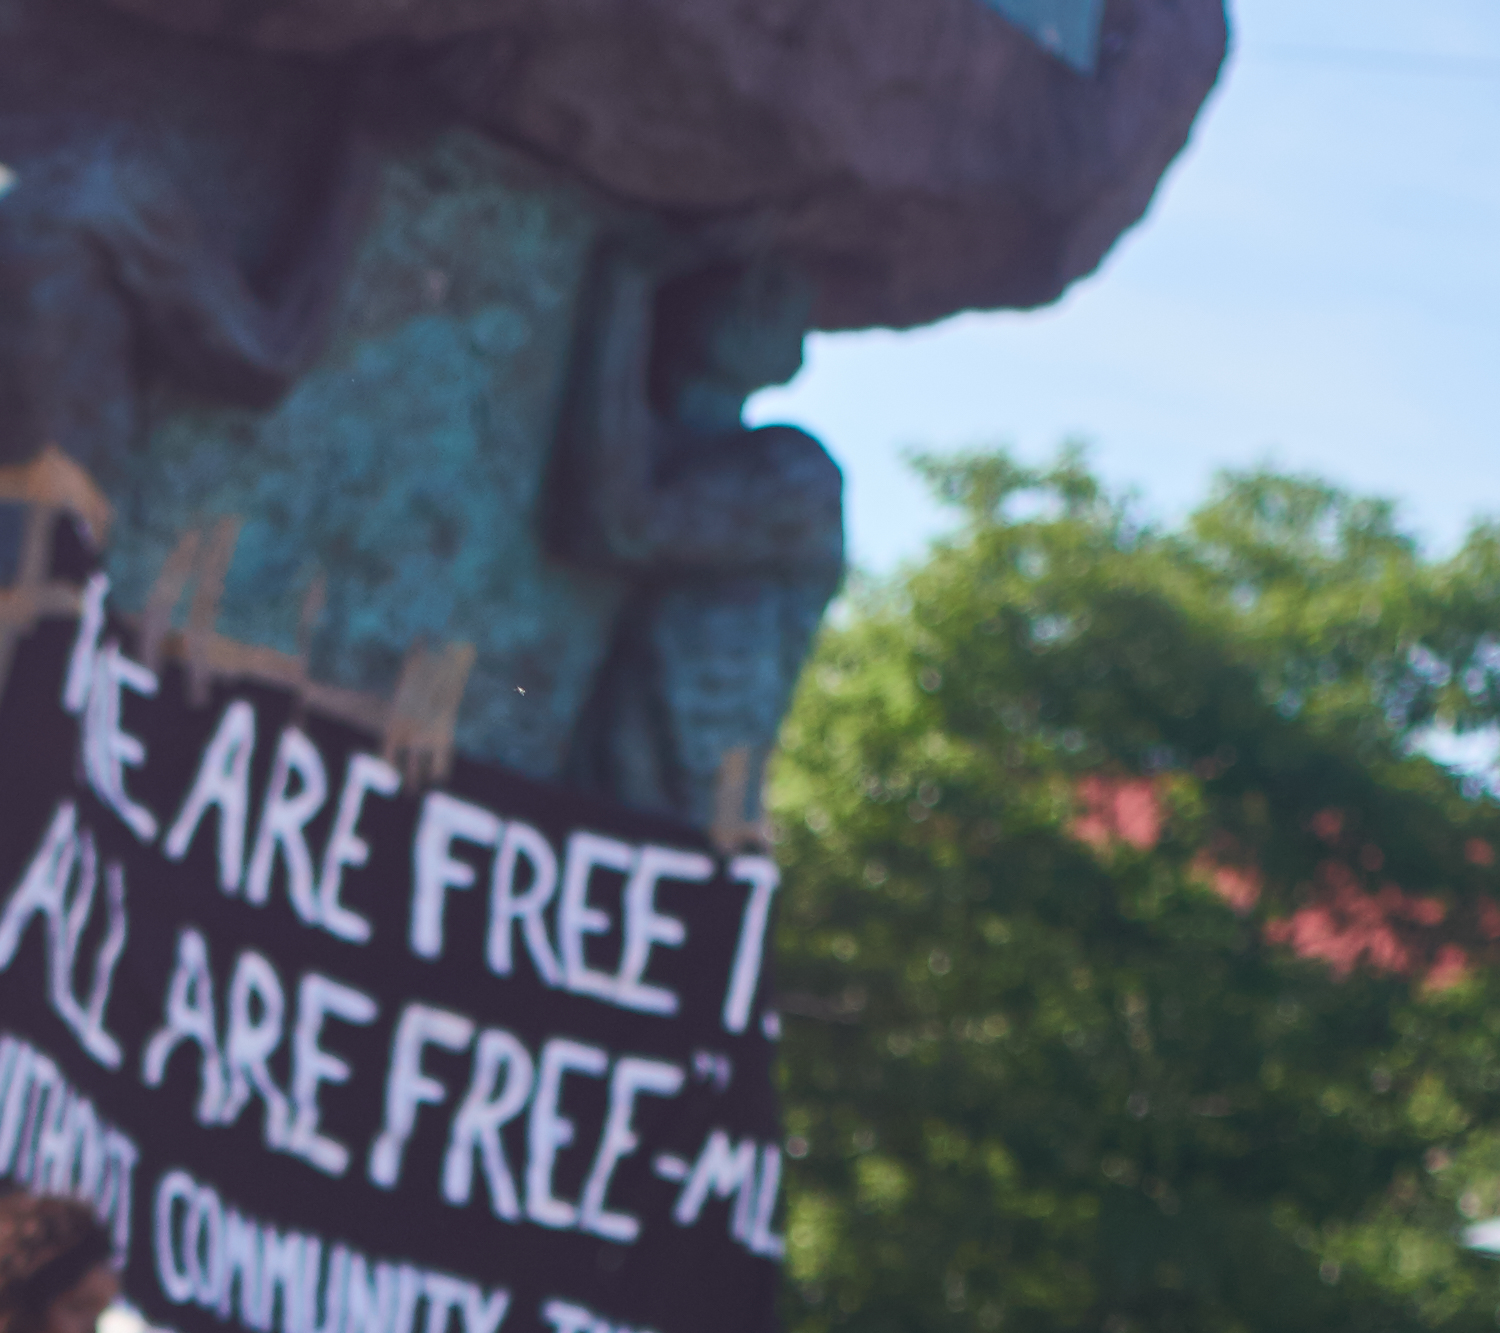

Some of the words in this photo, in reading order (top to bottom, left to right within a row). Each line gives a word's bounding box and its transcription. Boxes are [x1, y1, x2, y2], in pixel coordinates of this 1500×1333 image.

[163, 695, 402, 945] ARE
[408, 790, 714, 1017] FREE
[143, 928, 380, 1178] ARE
